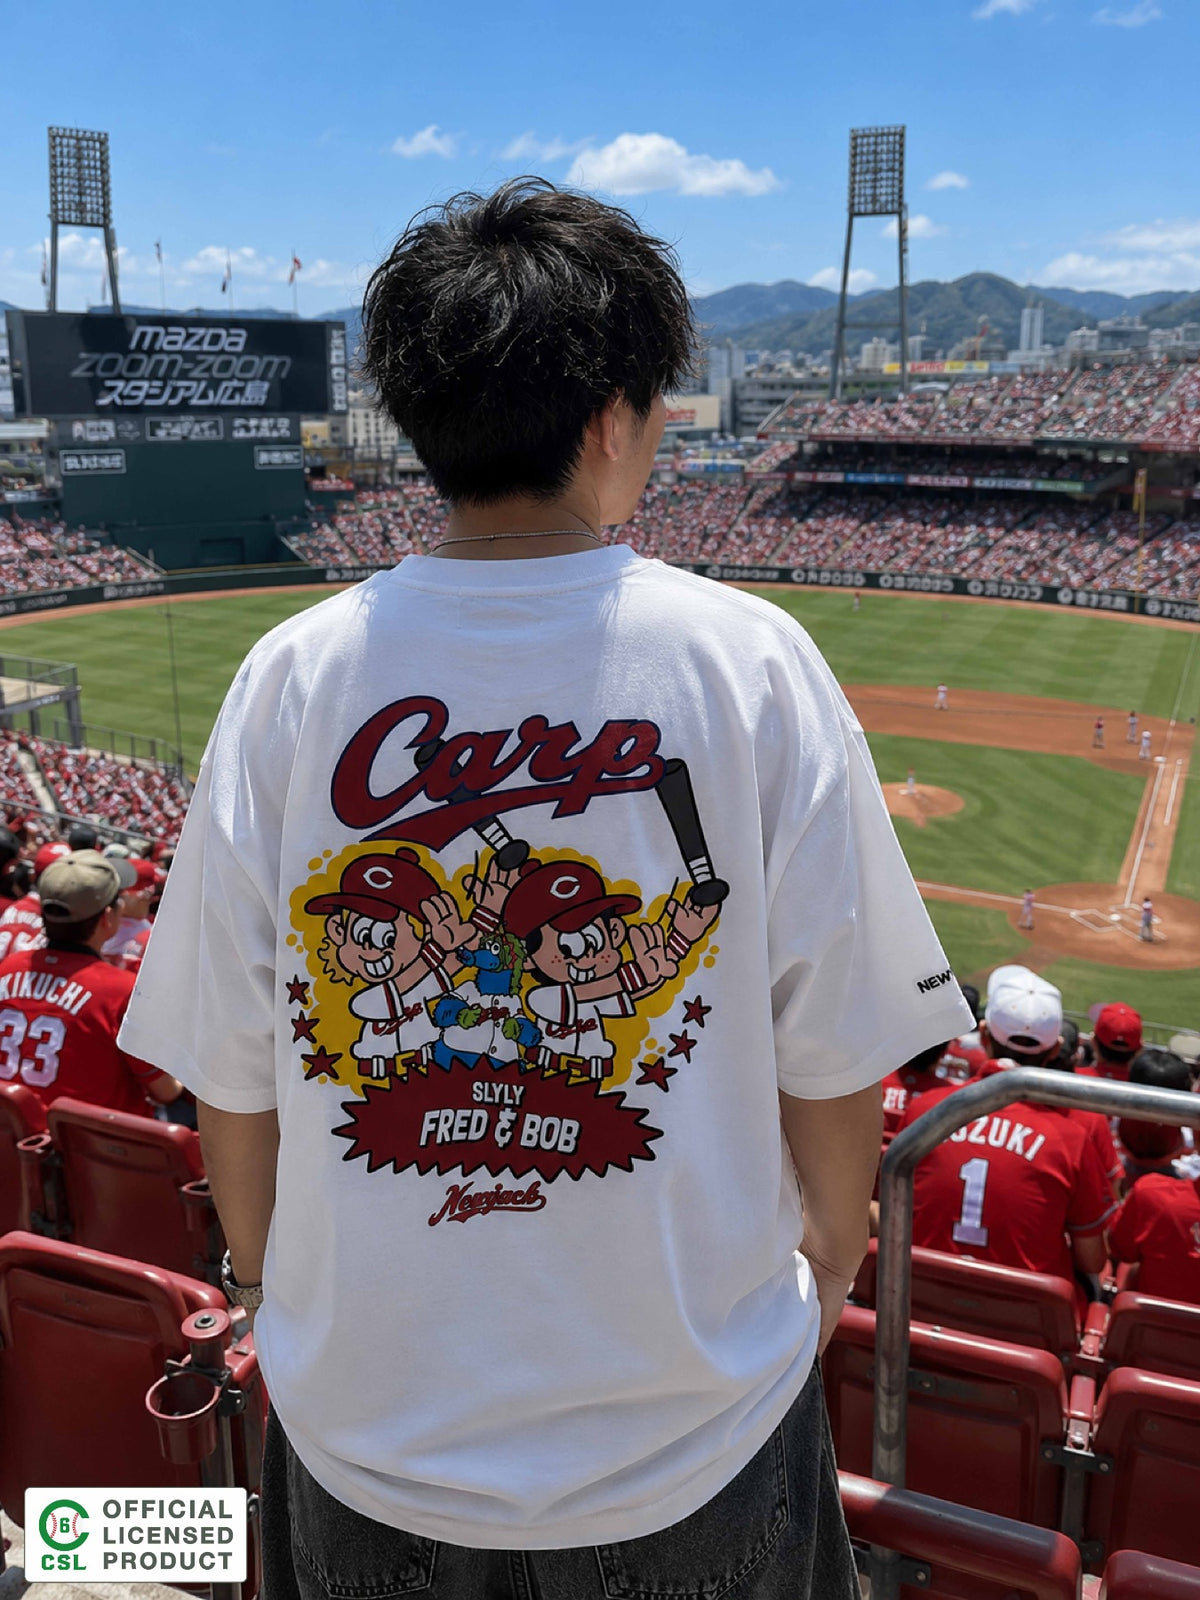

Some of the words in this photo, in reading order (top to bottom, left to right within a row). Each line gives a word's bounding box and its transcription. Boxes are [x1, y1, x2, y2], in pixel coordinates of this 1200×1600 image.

[95, 379, 270, 406] スタジアム広島
[331, 695, 667, 852] Carp
[0, 971, 93, 1016] KIKUCHI
[917, 969, 952, 994] NEW
[0, 1008, 67, 1088] 33
[472, 1081, 525, 1105] SLYLY
[419, 1108, 489, 1146] FRED
[495, 1107, 517, 1147] &
[520, 1113, 580, 1153] BOB
[953, 1157, 990, 1247] 1
